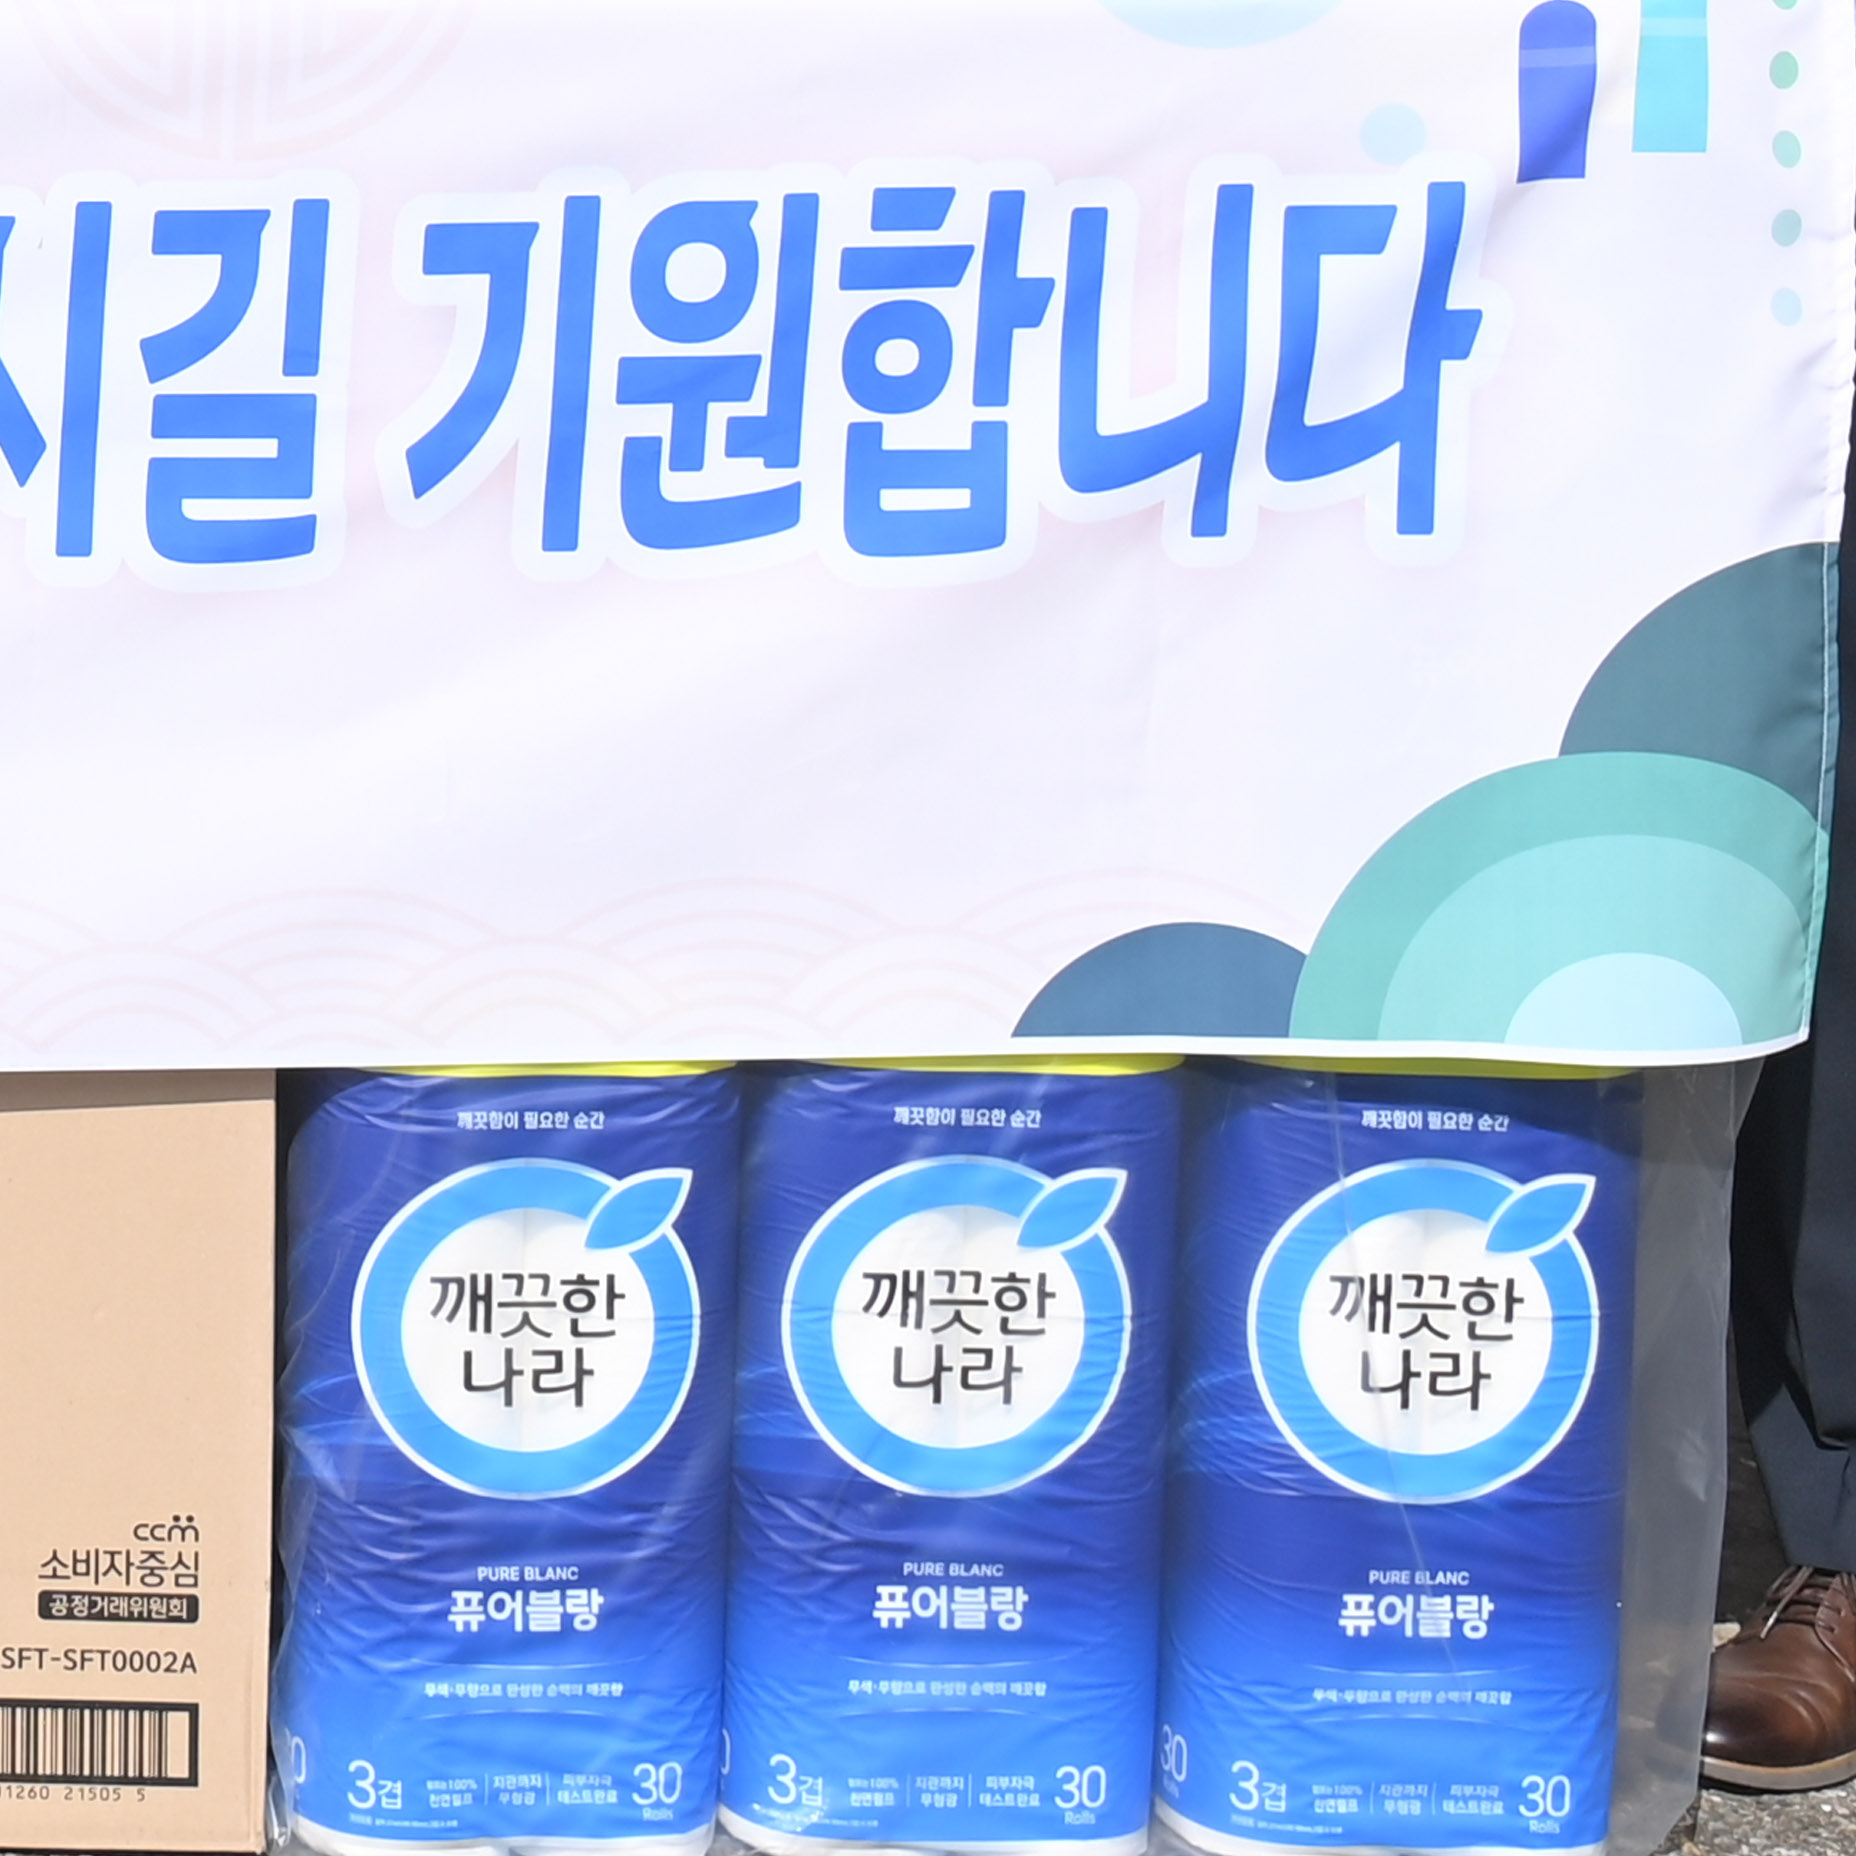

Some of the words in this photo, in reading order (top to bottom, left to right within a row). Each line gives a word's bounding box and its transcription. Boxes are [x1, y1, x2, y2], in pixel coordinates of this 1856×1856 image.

[404, 179, 1484, 558] 기원합니다
[430, 1272, 625, 1340] 깨끗한
[862, 1269, 1056, 1337] 깨끗한
[1329, 1272, 1525, 1342] 깨끗한
[462, 1347, 594, 1409] 나라
[892, 1343, 1022, 1406] 나라
[1360, 1350, 1493, 1412] 나라
[133, 1515, 199, 1542] ccm
[38, 1547, 199, 1588] 소비자중심
[476, 1566, 521, 1582] PURE
[525, 1566, 579, 1582] BLANC
[903, 1562, 945, 1577] PURE
[948, 1562, 1004, 1577] BLANC
[1369, 1571, 1412, 1585] PURE
[1414, 1571, 1469, 1586] BLANC
[49, 1594, 188, 1619] 공정거래위원회
[447, 1588, 605, 1633] 퓨어블랑
[872, 1584, 1029, 1631] 퓨어블랑
[1338, 1593, 1494, 1639] 퓨어블랑
[1, 1646, 198, 1674] SFT-SFT0002A
[346, 1760, 402, 1810] 3겹
[631, 1762, 682, 1805] 30
[767, 1754, 824, 1807] 3겹
[1054, 1765, 1107, 1809] 30
[1229, 1760, 1286, 1812] 3겹
[1518, 1775, 1571, 1818] 30
[642, 1807, 674, 1821] Rolls
[1064, 1810, 1096, 1825] Rolls
[1529, 1819, 1560, 1834] Rolls
